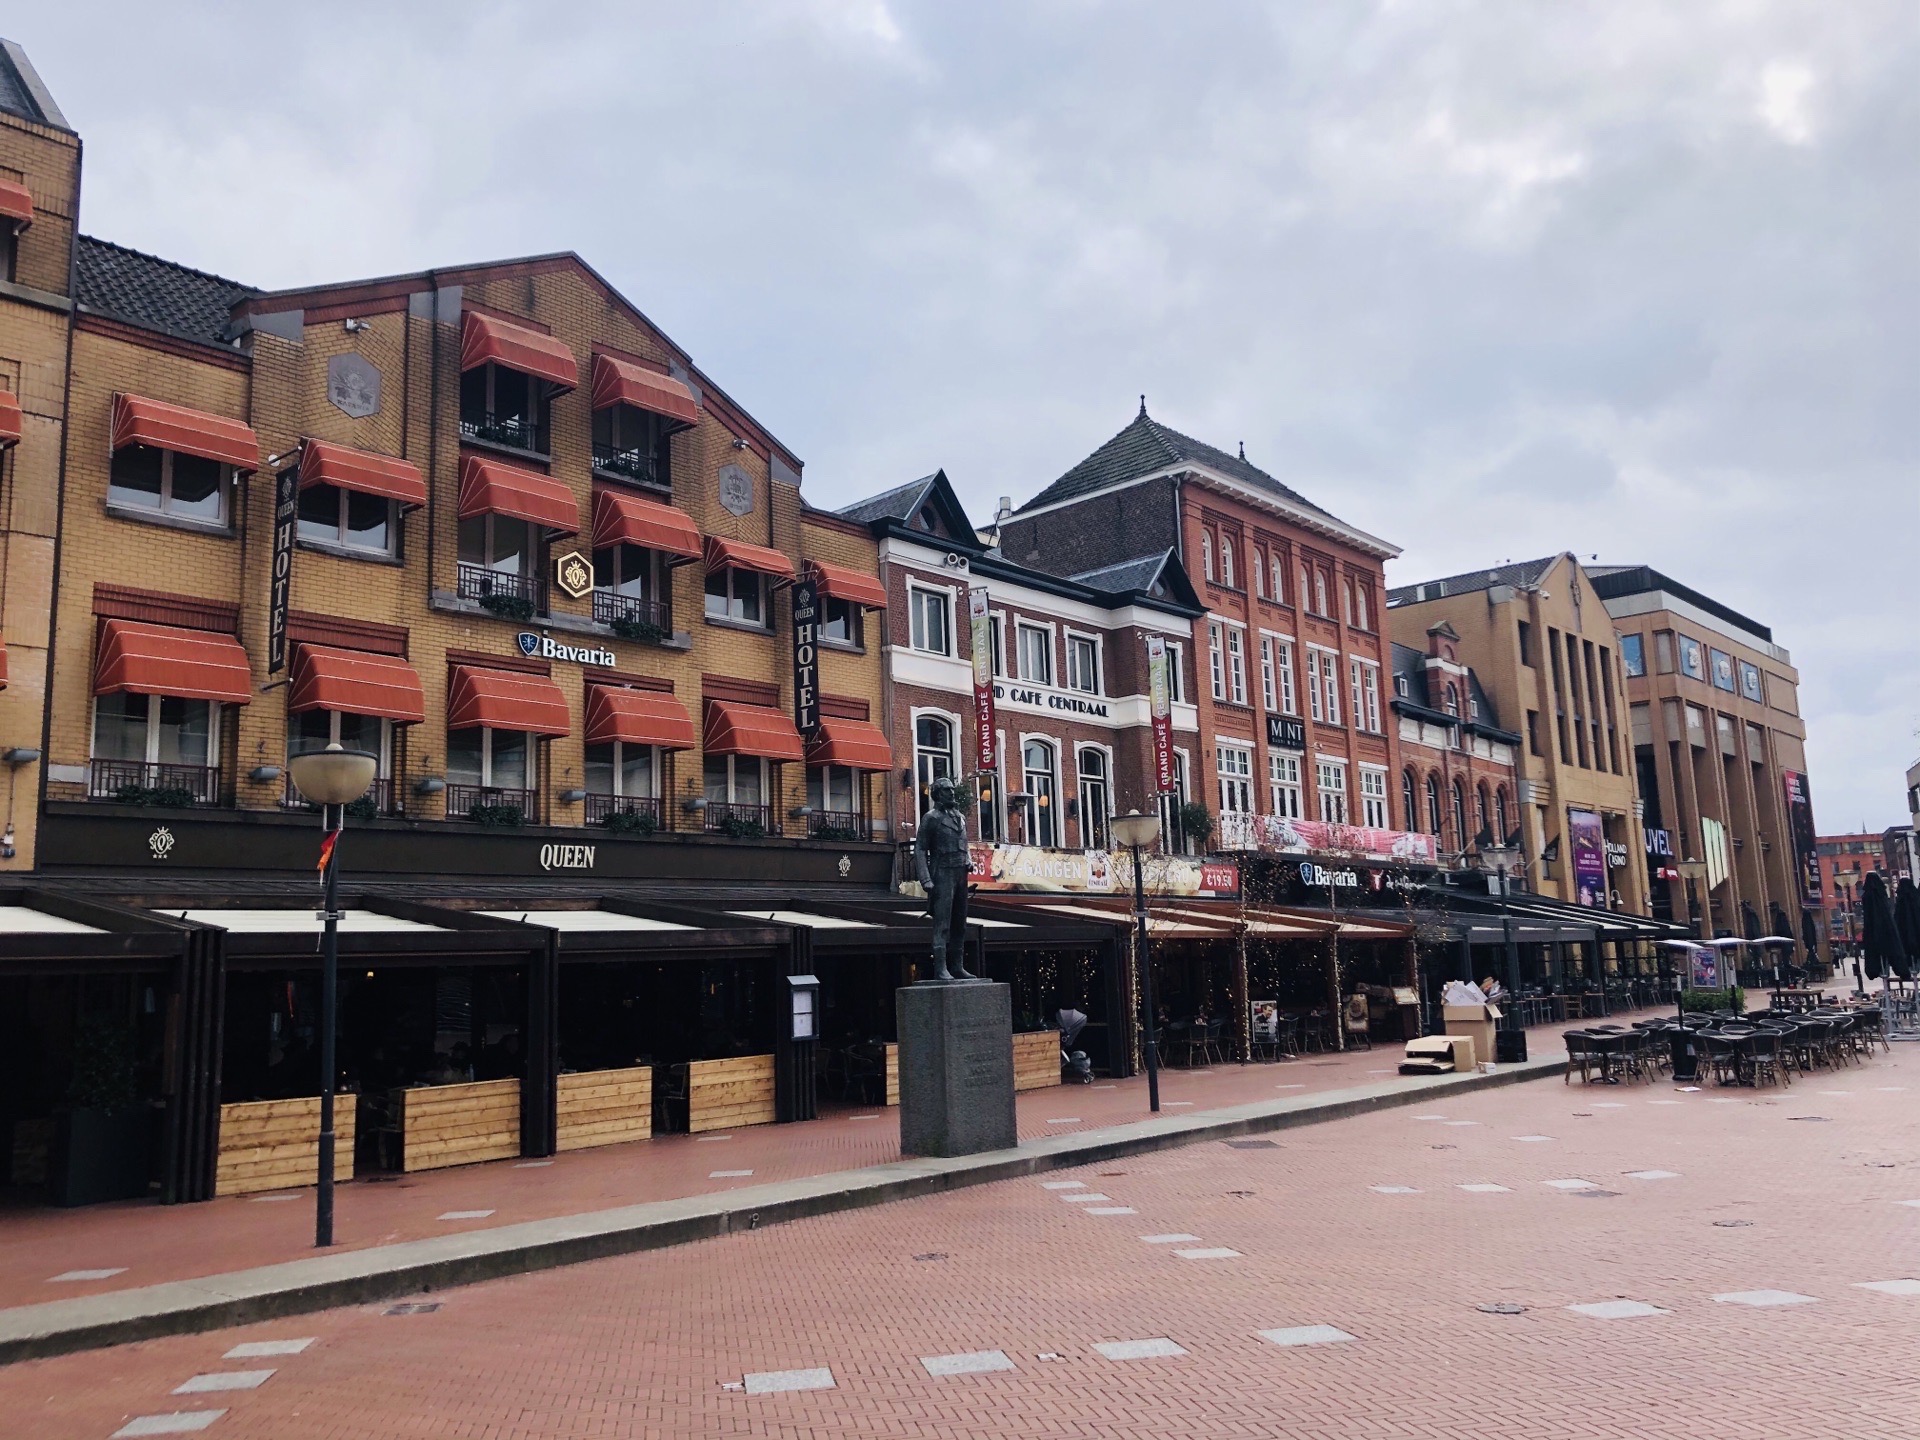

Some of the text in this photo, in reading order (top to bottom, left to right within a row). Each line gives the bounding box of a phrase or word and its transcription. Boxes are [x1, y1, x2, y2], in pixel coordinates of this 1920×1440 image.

[277, 500, 294, 520] QUEEN
[272, 522, 291, 664] HOTEL
[795, 606, 815, 620] QUEEN
[542, 637, 616, 667] Bavaria
[978, 624, 989, 684] CENTRAAL
[797, 623, 815, 728] HOTEL
[1155, 665, 1165, 716] CENTRAAL
[978, 691, 989, 721] CAFÉ
[1010, 688, 1043, 706] CAFE
[1048, 695, 1109, 718] CENTRAAL
[982, 724, 991, 763] GRAND
[1156, 722, 1167, 748] CAFÉ
[1159, 751, 1169, 786] GRAND
[540, 843, 596, 871] QUEEN
[1206, 874, 1232, 887] €19.50
[1313, 865, 1358, 888] Bavaria
